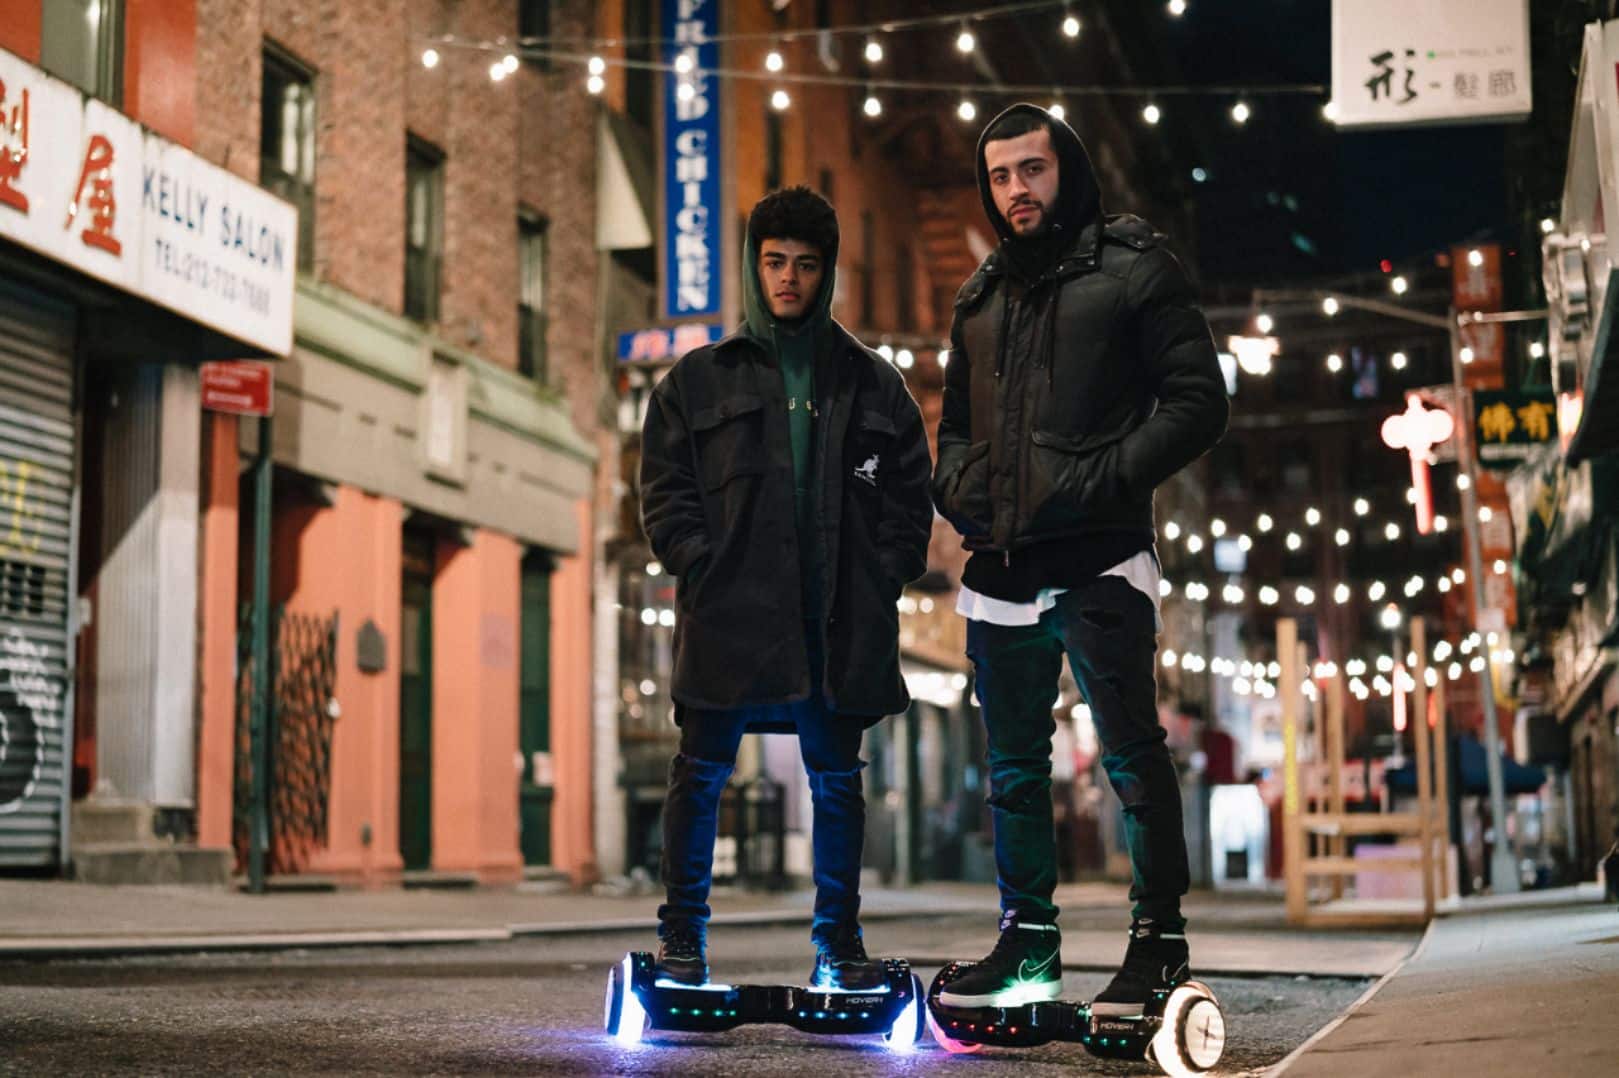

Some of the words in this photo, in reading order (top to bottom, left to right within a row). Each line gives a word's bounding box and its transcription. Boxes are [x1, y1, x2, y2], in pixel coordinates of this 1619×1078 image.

[142, 163, 209, 236] KELLY
[222, 203, 284, 273] SALON
[675, 129, 710, 312] CHICKEN
